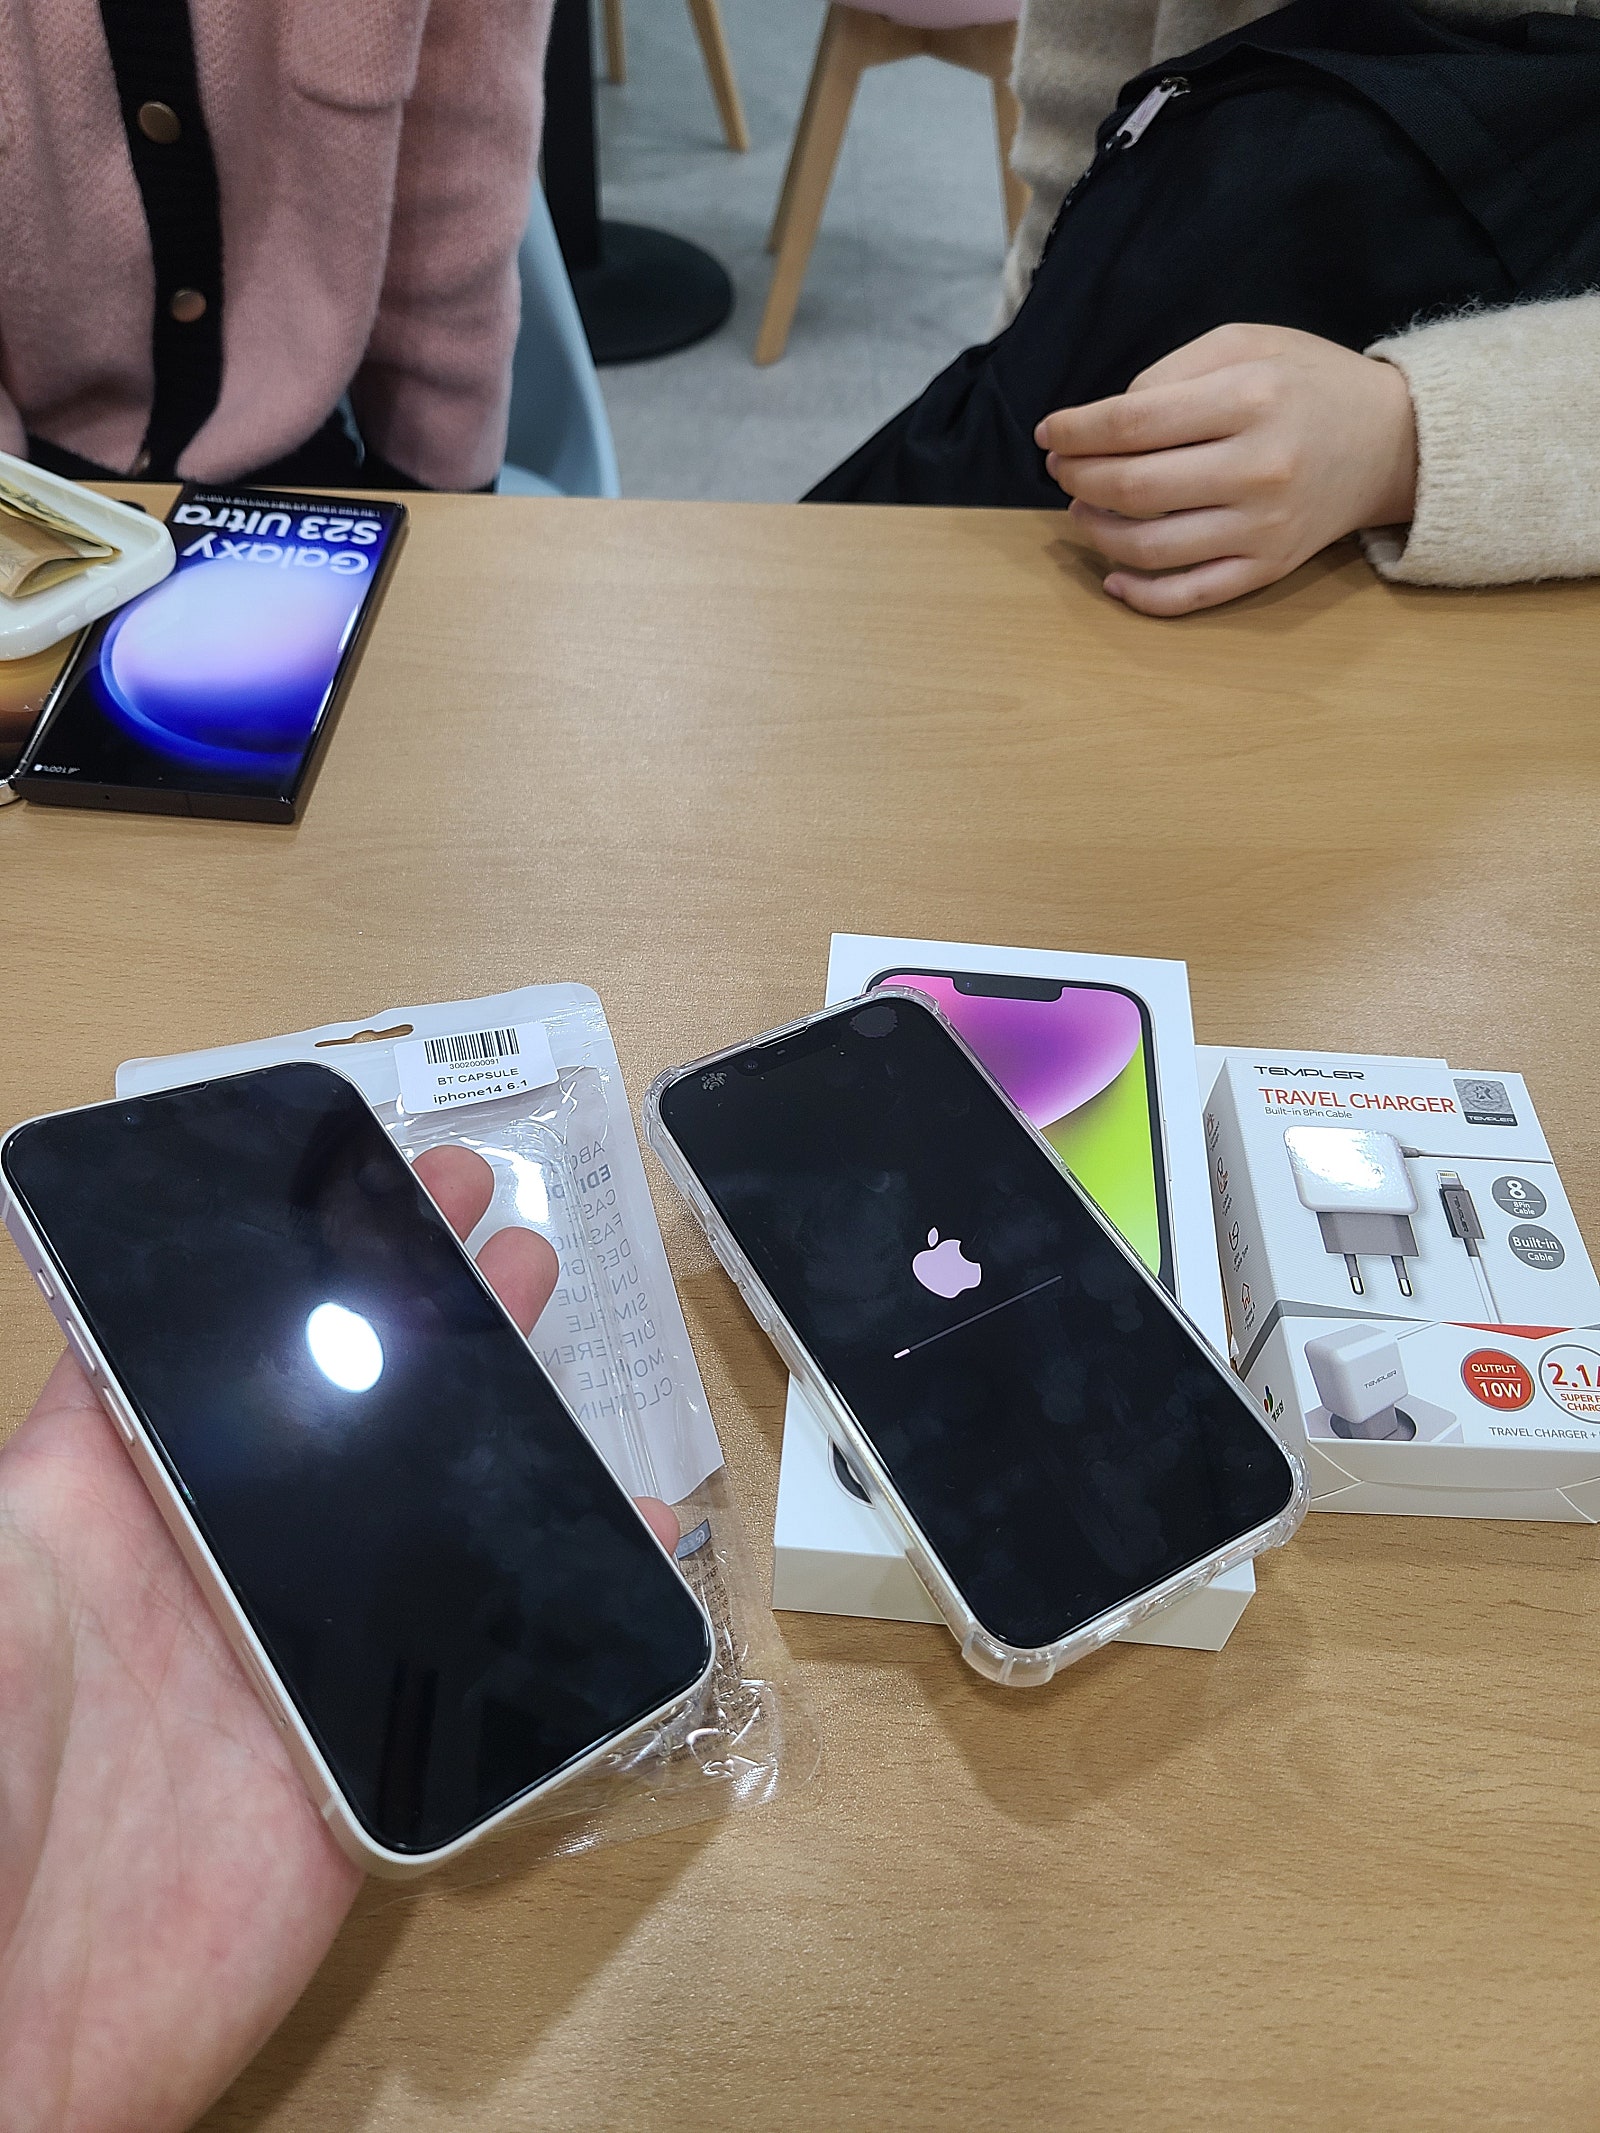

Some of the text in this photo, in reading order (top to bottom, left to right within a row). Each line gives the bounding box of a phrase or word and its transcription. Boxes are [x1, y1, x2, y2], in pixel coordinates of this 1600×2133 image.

[172, 502, 292, 538] Ultra
[297, 514, 382, 545] S23
[181, 531, 369, 576] Galaxy
[449, 1058, 500, 1070] 3002000091
[437, 1067, 520, 1086] BT CAPSULE
[1253, 1065, 1365, 1080] TEMPLER
[433, 1079, 528, 1105] iphone14 6.1
[1258, 1088, 1457, 1114] TRAVEL CHARGER
[1264, 1106, 1353, 1119] Built-in 8Pin Cable
[1467, 1115, 1514, 1123] TEMPLER
[1506, 1179, 1527, 1200] 8
[1513, 1201, 1531, 1209] 8Pin
[1513, 1207, 1536, 1216] Cable
[1512, 1236, 1559, 1250] Built-in
[1527, 1252, 1554, 1263] Cable
[1471, 1363, 1517, 1375] OUTPUT
[1479, 1381, 1522, 1399] 10W
[1560, 1393, 1594, 1403] SUPER
[1488, 1427, 1533, 1437] TRAVEL
[1534, 1428, 1588, 1440] CHARGER
